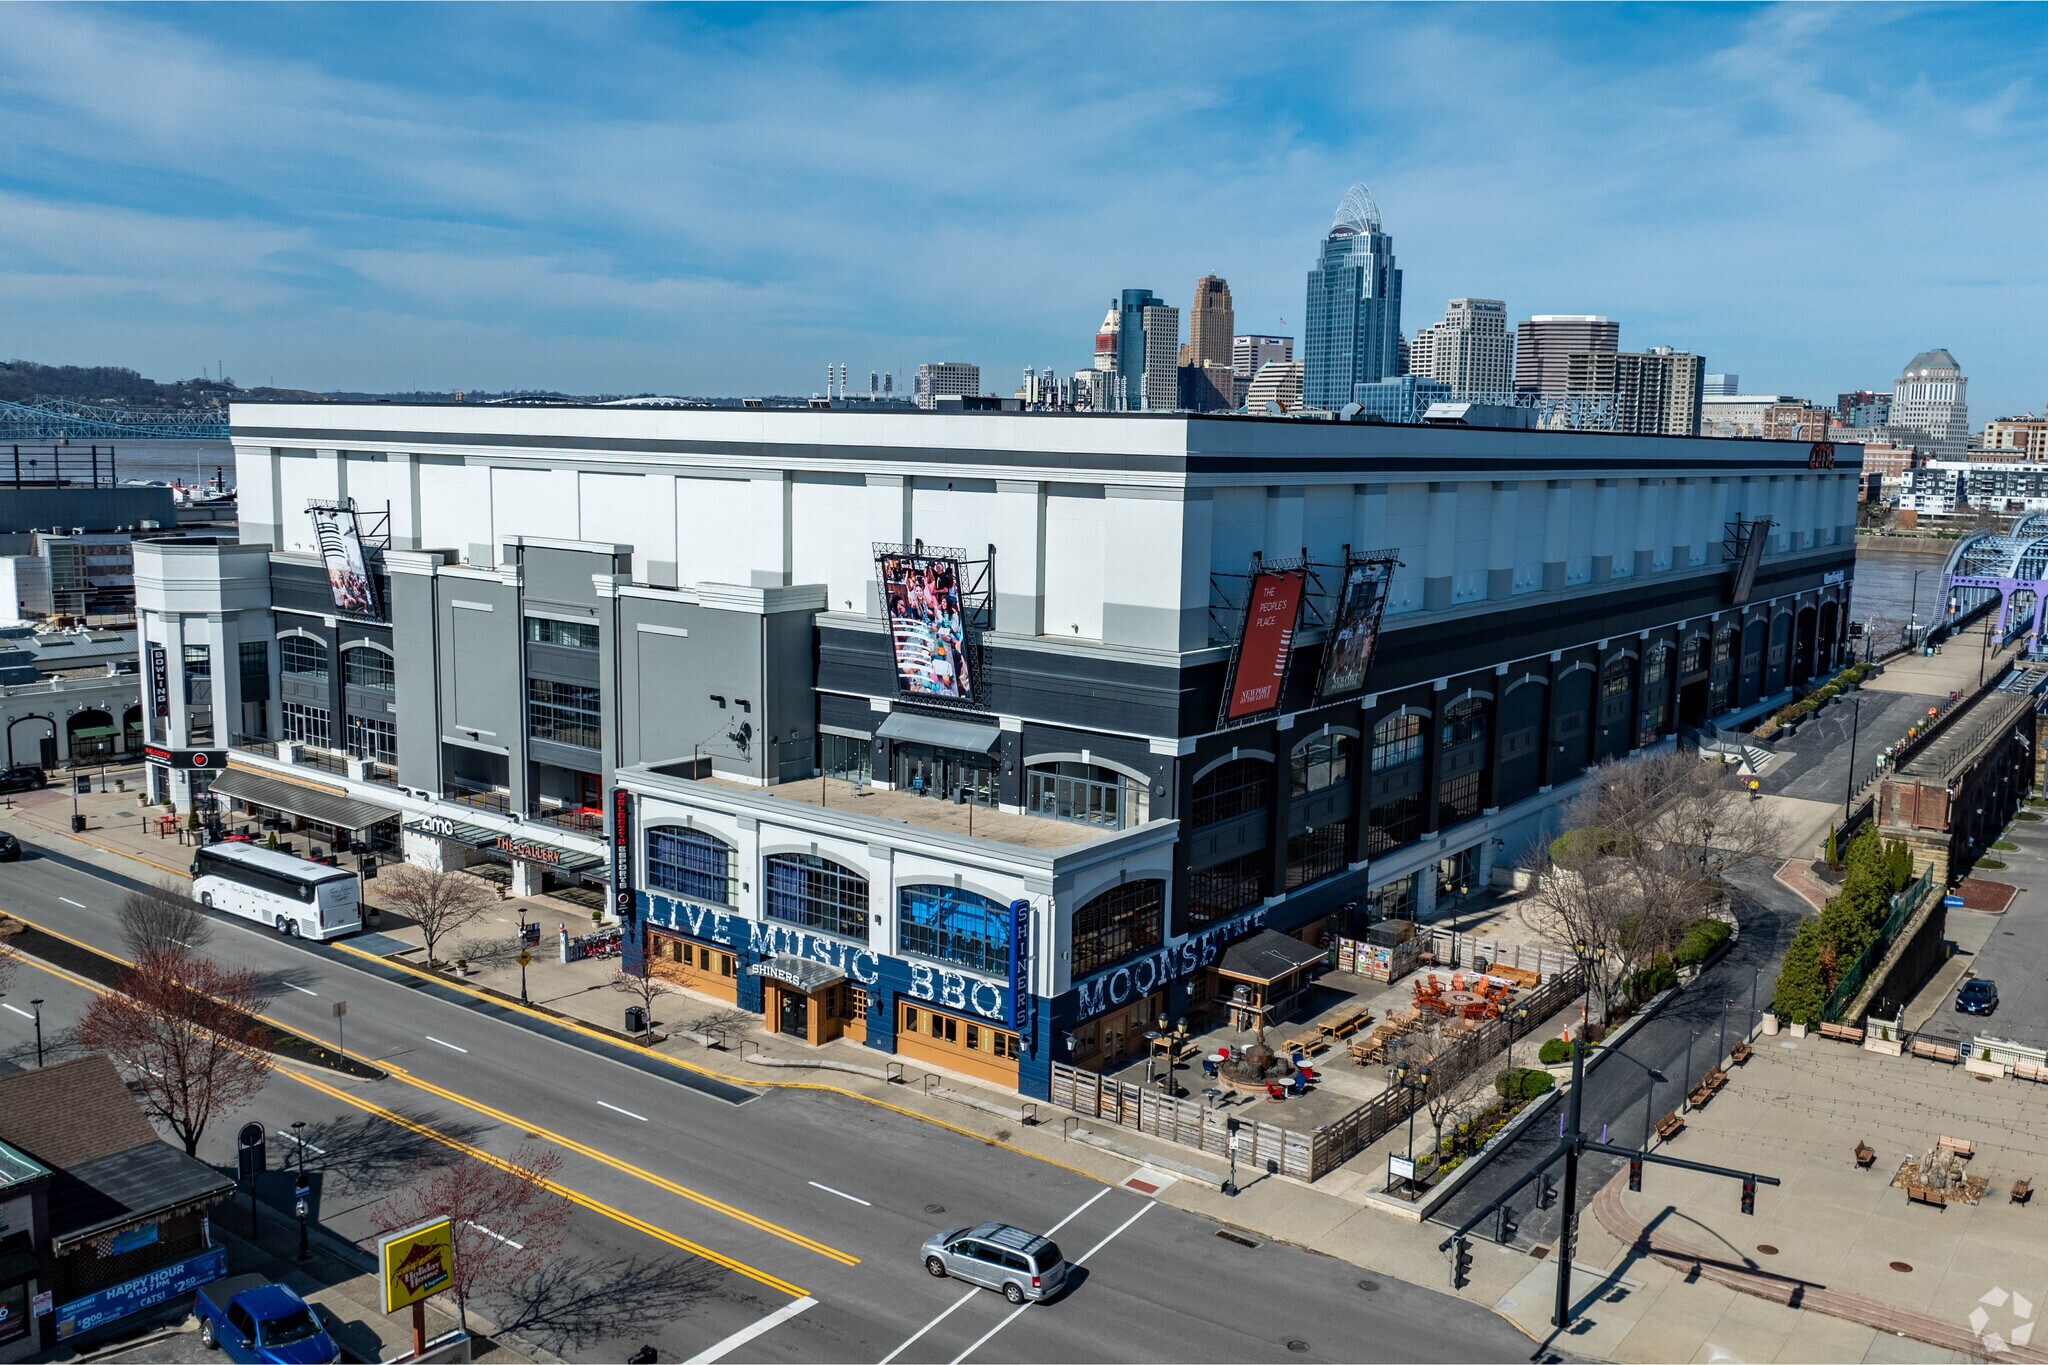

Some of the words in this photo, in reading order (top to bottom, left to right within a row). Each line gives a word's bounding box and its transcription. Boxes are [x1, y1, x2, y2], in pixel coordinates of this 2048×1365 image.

[1263, 587, 1275, 597] THE
[1259, 600, 1287, 612] PEOPLE'S
[155, 651, 166, 703] BOWLING
[1242, 685, 1272, 698] NEWPORT
[496, 836, 514, 852] THE
[517, 843, 561, 863] GALLERY
[646, 892, 731, 945] LIVE
[749, 919, 879, 985] MUSIC
[908, 963, 1004, 1022] BBQ
[1016, 907, 1028, 1024] SHINERS
[752, 964, 801, 986] SHINERS
[404, 1260, 441, 1283] Holiday
[410, 1268, 439, 1288] House
[424, 1272, 448, 1288] Liquors
[106, 1277, 148, 1300] HAPPY
[150, 1264, 185, 1284] HOUR
[128, 1291, 134, 1299] 4
[134, 1286, 147, 1297] TO
[149, 1282, 156, 1292] 7
[156, 1279, 170, 1290] PM
[62, 1302, 78, 1313] BUD
[77, 1297, 96, 1309] LIGHT
[140, 1291, 166, 1307] CATS!
